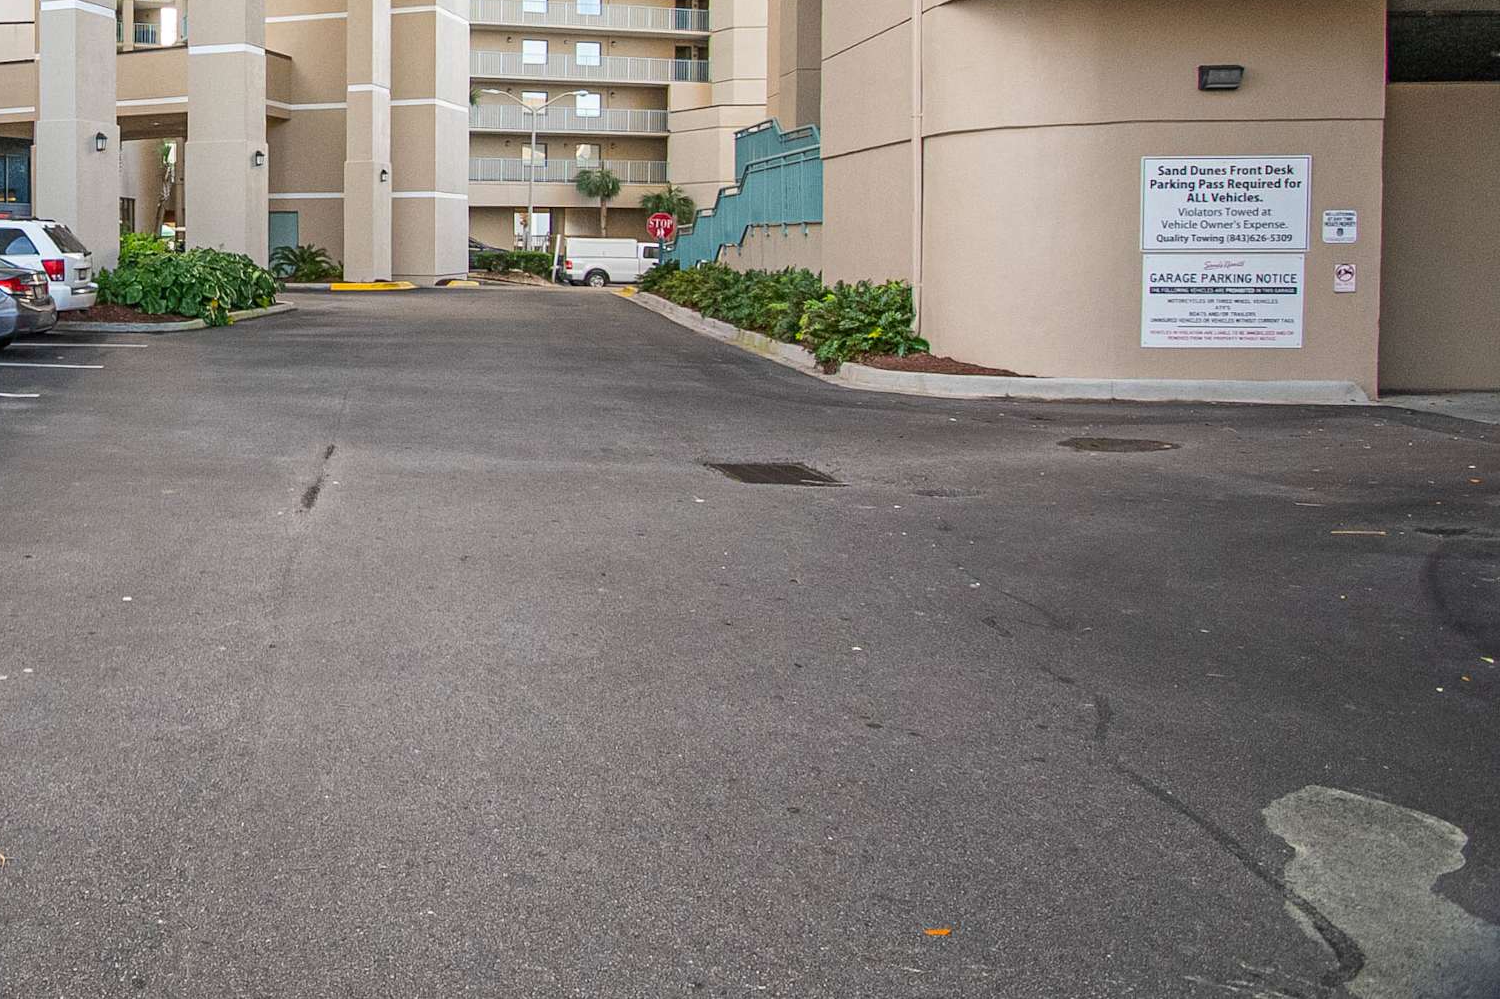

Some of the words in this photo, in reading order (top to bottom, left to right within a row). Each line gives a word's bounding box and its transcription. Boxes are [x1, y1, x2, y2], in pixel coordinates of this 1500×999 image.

[1158, 165, 1187, 175] Sand
[1190, 166, 1227, 175] Dunes
[1230, 165, 1262, 175] Front
[1265, 164, 1294, 175] Desk
[1150, 179, 1195, 191] Parking
[1199, 179, 1225, 189] Pass
[1227, 178, 1281, 191] Required
[1284, 178, 1302, 188] for
[1187, 193, 1208, 202] ALL
[1211, 192, 1263, 202] Vehicles.
[1178, 207, 1222, 217] Violators
[1225, 207, 1259, 217] Towed
[1261, 208, 1272, 216] at
[649, 218, 673, 229] STOP
[1161, 220, 1198, 229] Vehicle
[1200, 220, 1241, 229] Owner's
[1243, 220, 1289, 231] Expense.
[1156, 234, 1189, 244] Quality
[1191, 234, 1225, 244] Towing
[1227, 234, 1293, 243] (843)626-5309
[1150, 273, 1197, 283] GARAGE
[1201, 273, 1252, 283] PARKING
[1256, 273, 1298, 284] NOTICE
